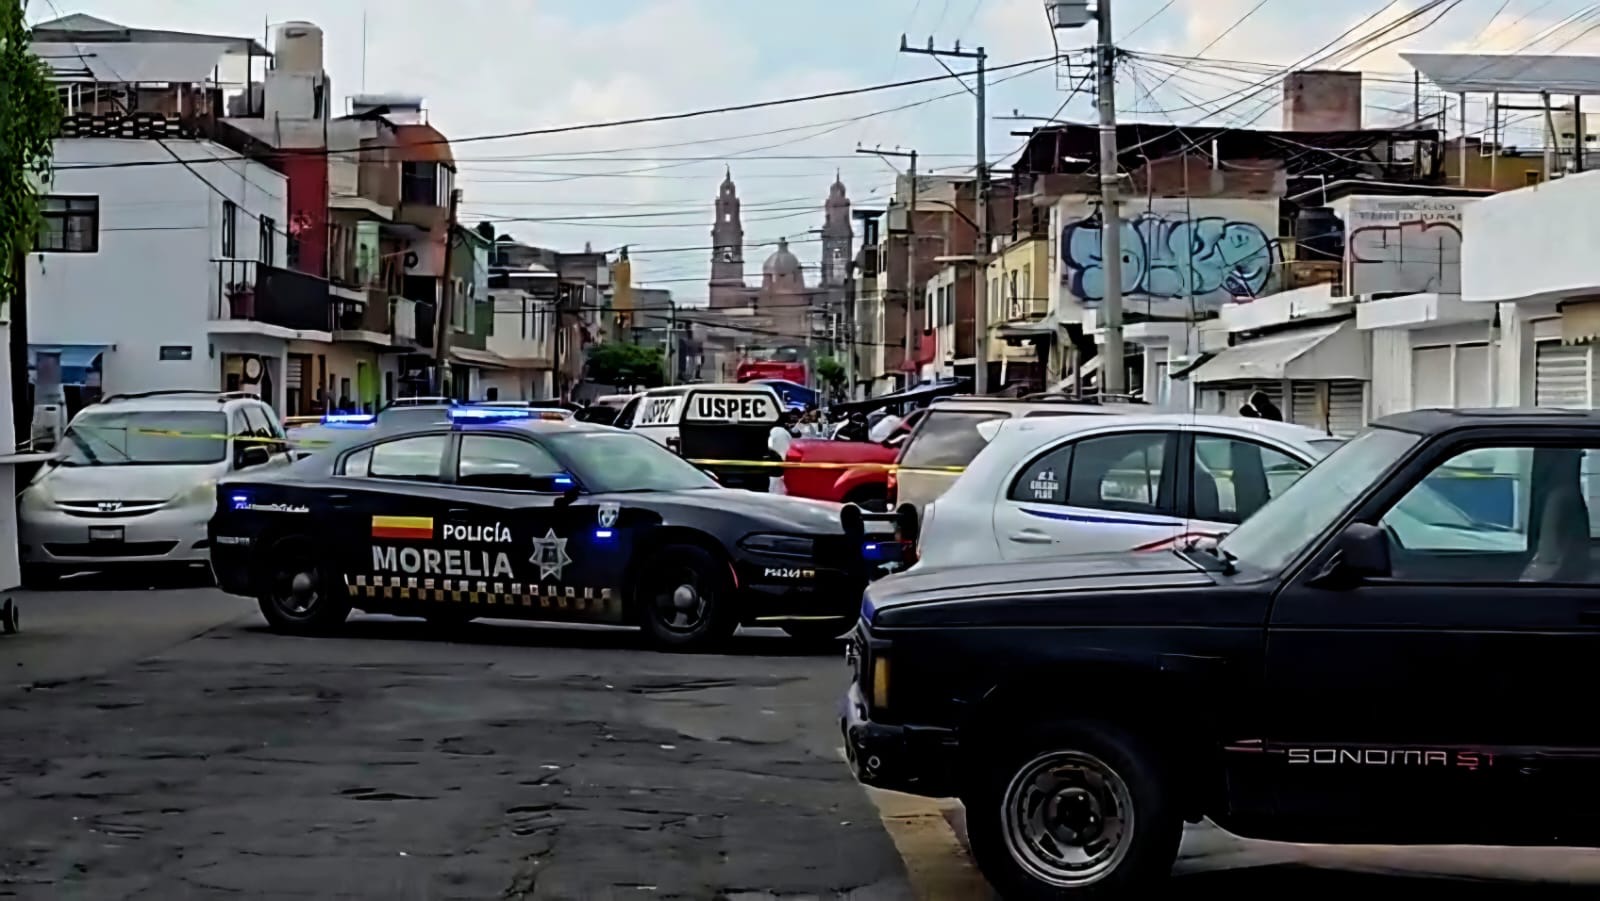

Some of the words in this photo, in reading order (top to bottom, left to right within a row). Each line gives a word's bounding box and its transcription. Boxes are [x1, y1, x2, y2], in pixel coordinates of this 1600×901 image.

[698, 397, 767, 419] USPEC
[443, 521, 513, 543] POLICÍA
[372, 545, 514, 579] MORELIA
[1288, 748, 1447, 766] SONOMA
